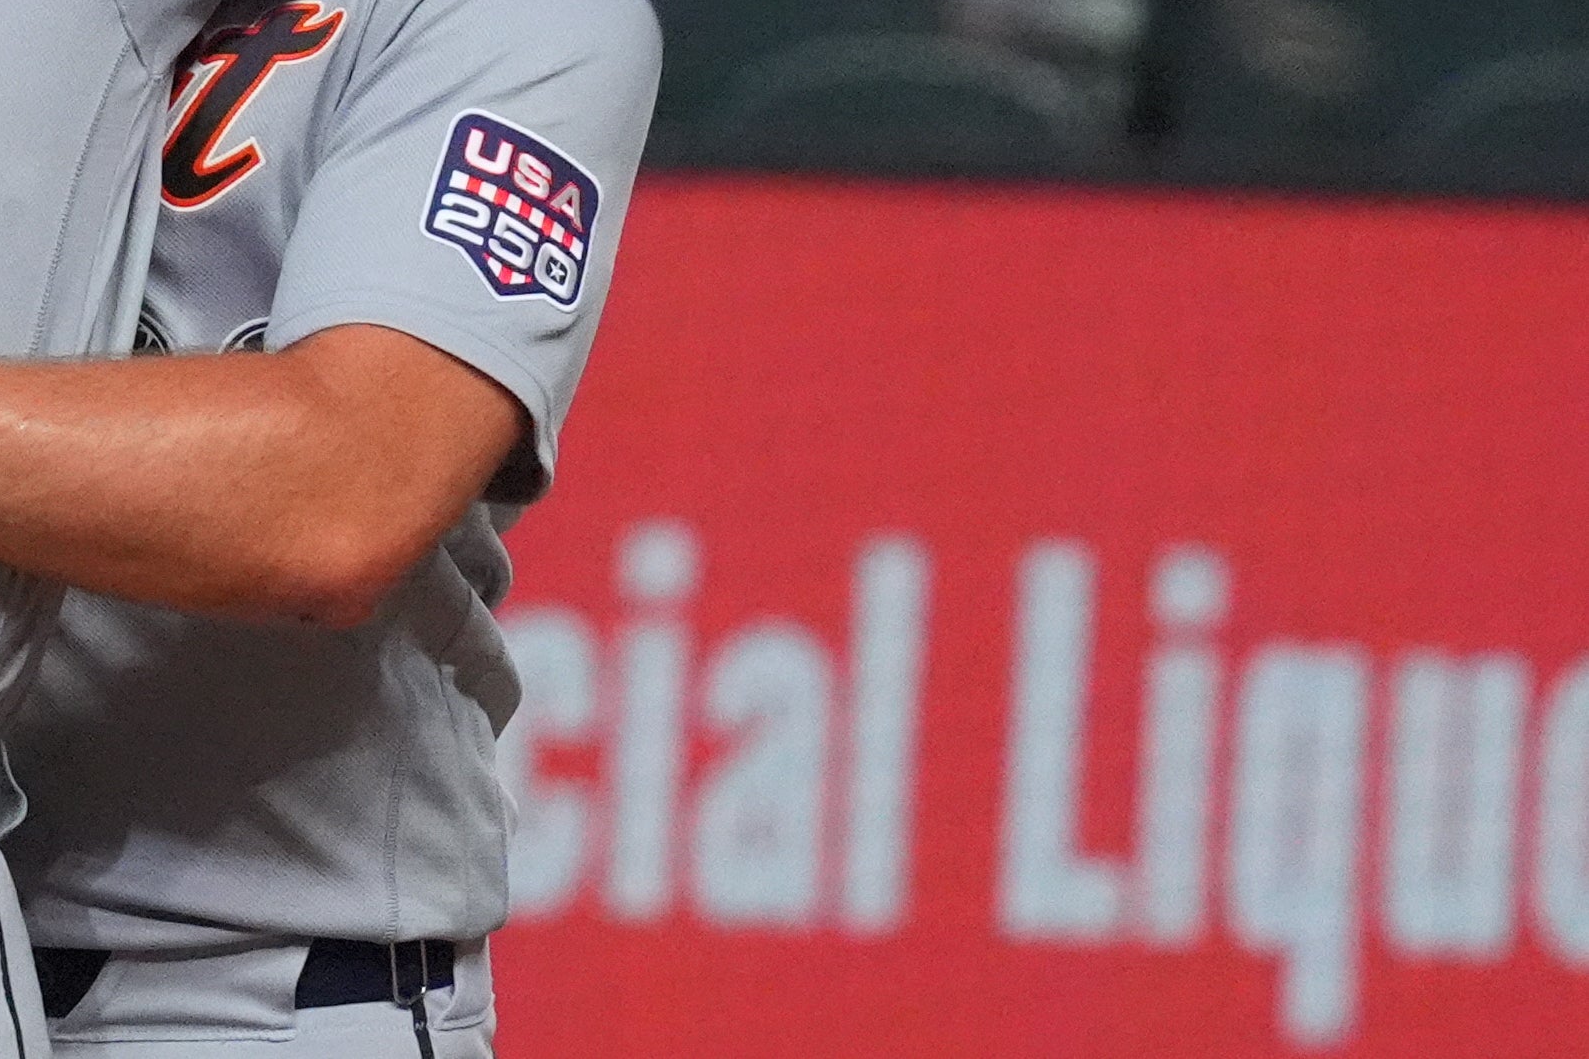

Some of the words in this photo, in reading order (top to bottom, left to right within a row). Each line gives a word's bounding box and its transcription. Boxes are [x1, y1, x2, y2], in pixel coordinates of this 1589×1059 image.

[160, 0, 346, 212] t
[464, 127, 584, 234] USA
[432, 192, 578, 301] 250
